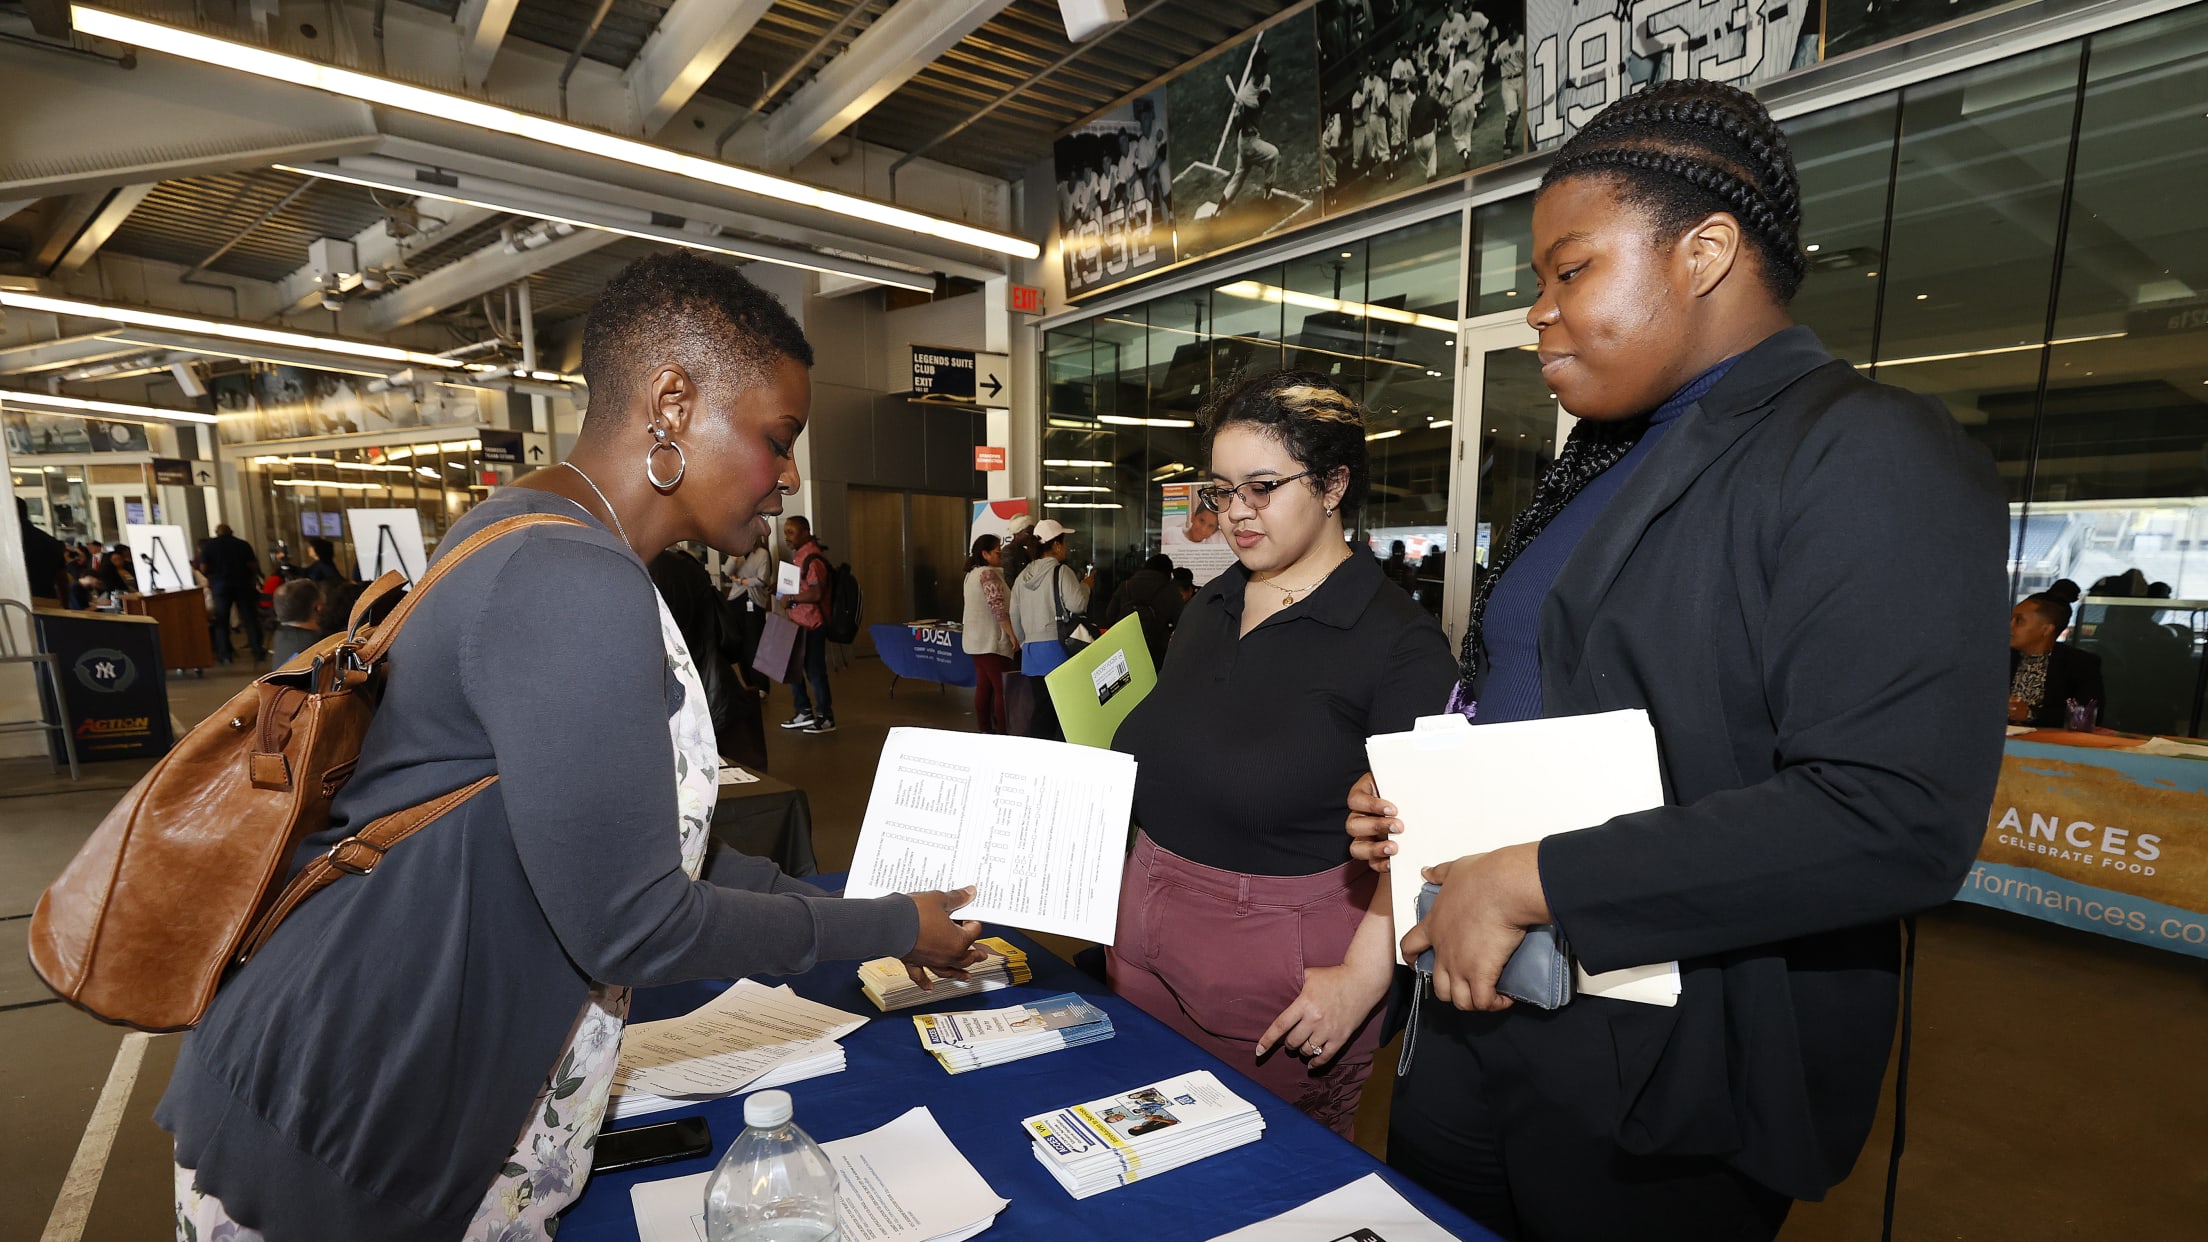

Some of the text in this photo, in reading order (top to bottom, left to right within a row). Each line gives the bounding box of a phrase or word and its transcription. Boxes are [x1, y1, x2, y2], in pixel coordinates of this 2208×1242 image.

[1067, 198, 1157, 290] 1952
[1013, 286, 1038, 311] EXIT
[914, 353, 974, 369] LEGENDS SUITE
[914, 363, 935, 375] CLUB
[914, 376, 934, 388] EXIT
[922, 628, 952, 647] DUSA
[76, 717, 149, 735] ACTION
[1987, 806, 2161, 861] ANCES
[1998, 833, 2157, 877] CELEBRATE FOOD
[1035, 1124, 1046, 1133] VR
[1047, 1136, 1068, 1153] ACCES
